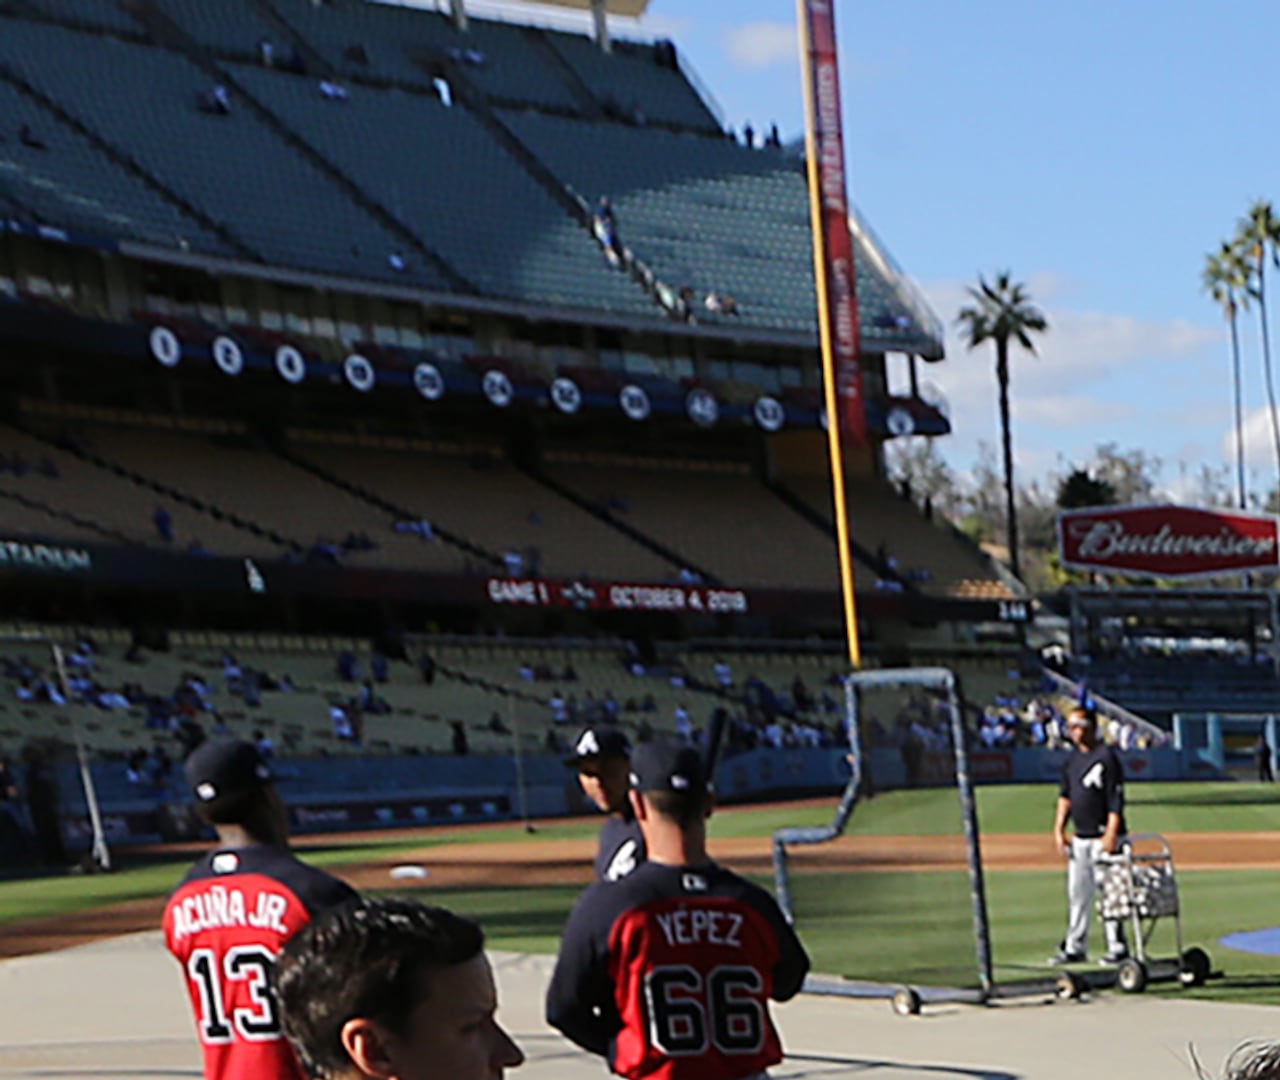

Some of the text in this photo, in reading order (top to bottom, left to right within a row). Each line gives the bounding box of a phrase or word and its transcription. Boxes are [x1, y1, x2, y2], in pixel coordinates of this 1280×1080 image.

[1067, 521, 1275, 559] Budweiser
[488, 578, 536, 603] GAME
[610, 584, 685, 609] OCTOBER
[172, 886, 288, 940] ACUÑA JR.
[188, 944, 283, 1045] 13
[644, 964, 765, 1056] 66
